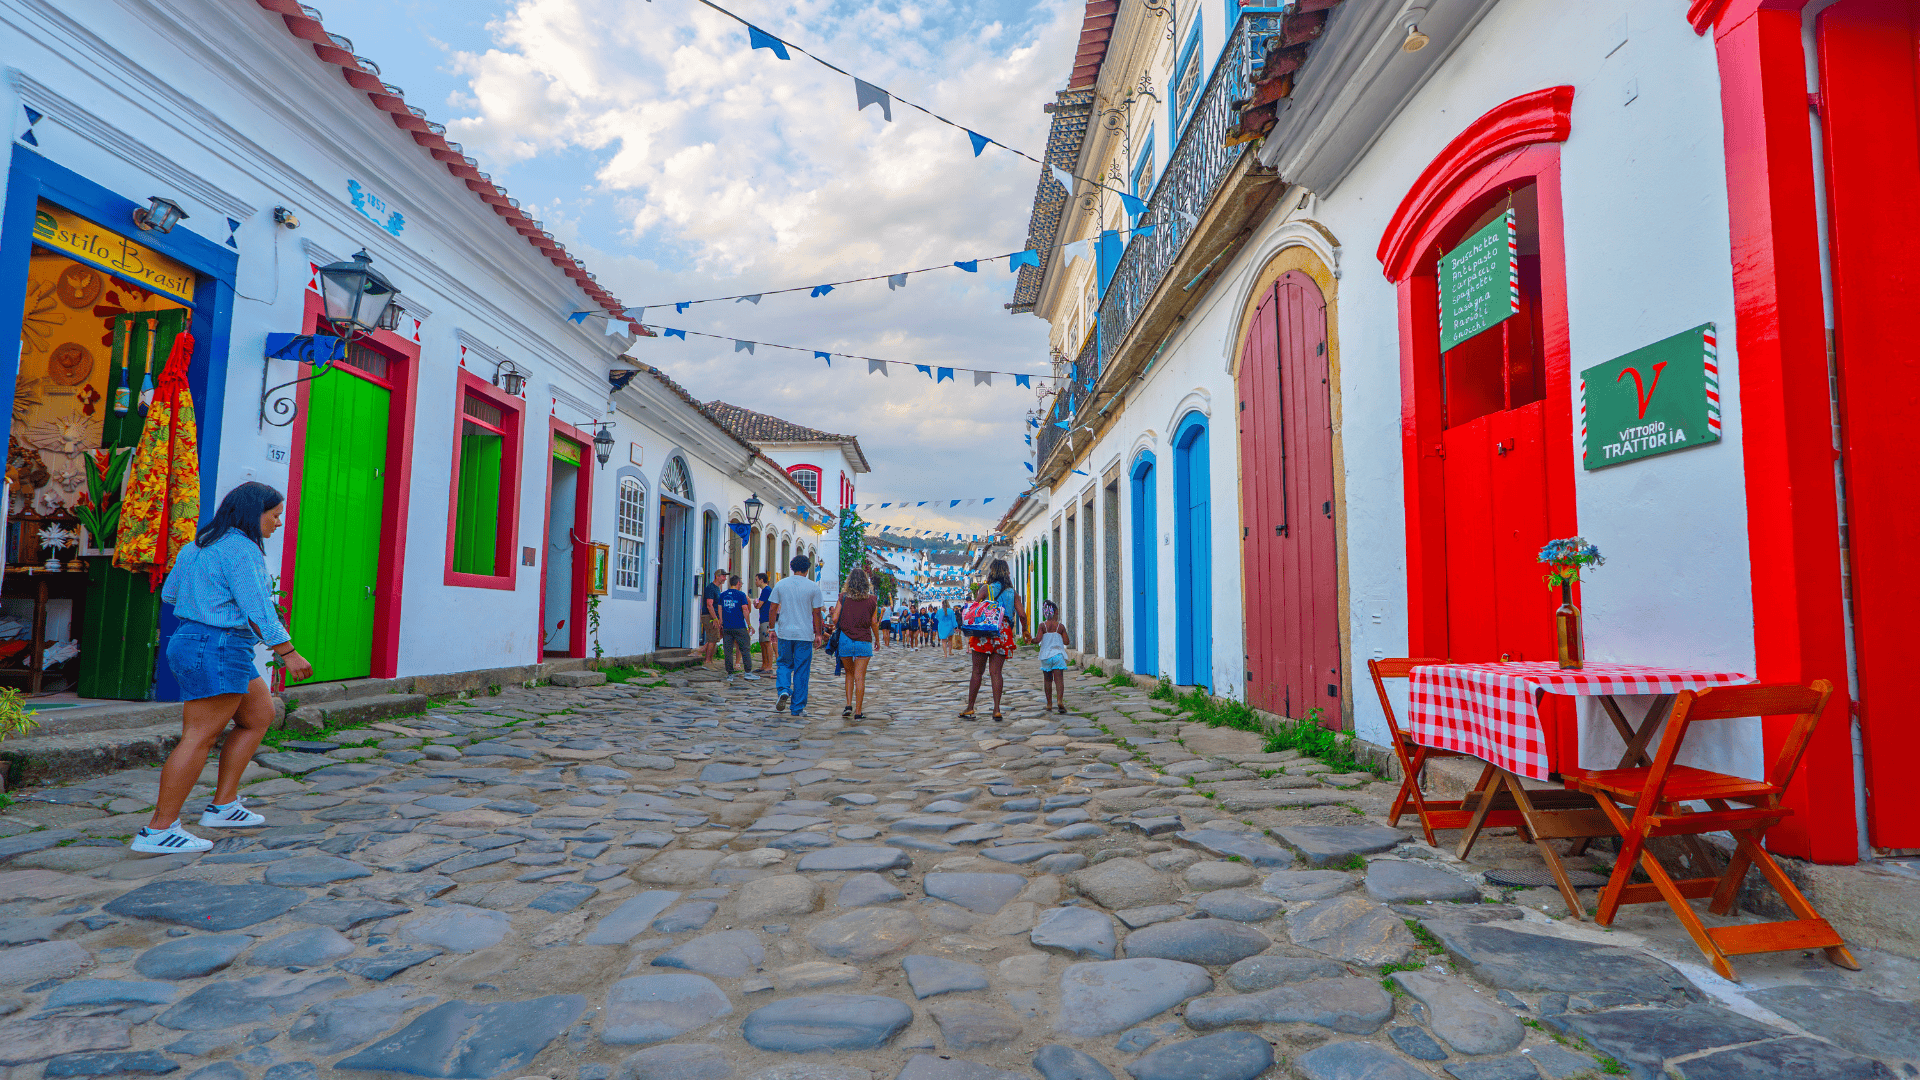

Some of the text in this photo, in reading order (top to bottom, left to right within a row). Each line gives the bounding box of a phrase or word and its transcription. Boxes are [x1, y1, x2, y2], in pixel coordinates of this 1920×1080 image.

[111, 239, 190, 295] Brasil
[1451, 233, 1499, 270] Bruschetta
[1452, 247, 1498, 282] Antipasto
[1454, 291, 1490, 317] Lasagna
[1617, 360, 1668, 420] V
[271, 449, 286, 461] 157
